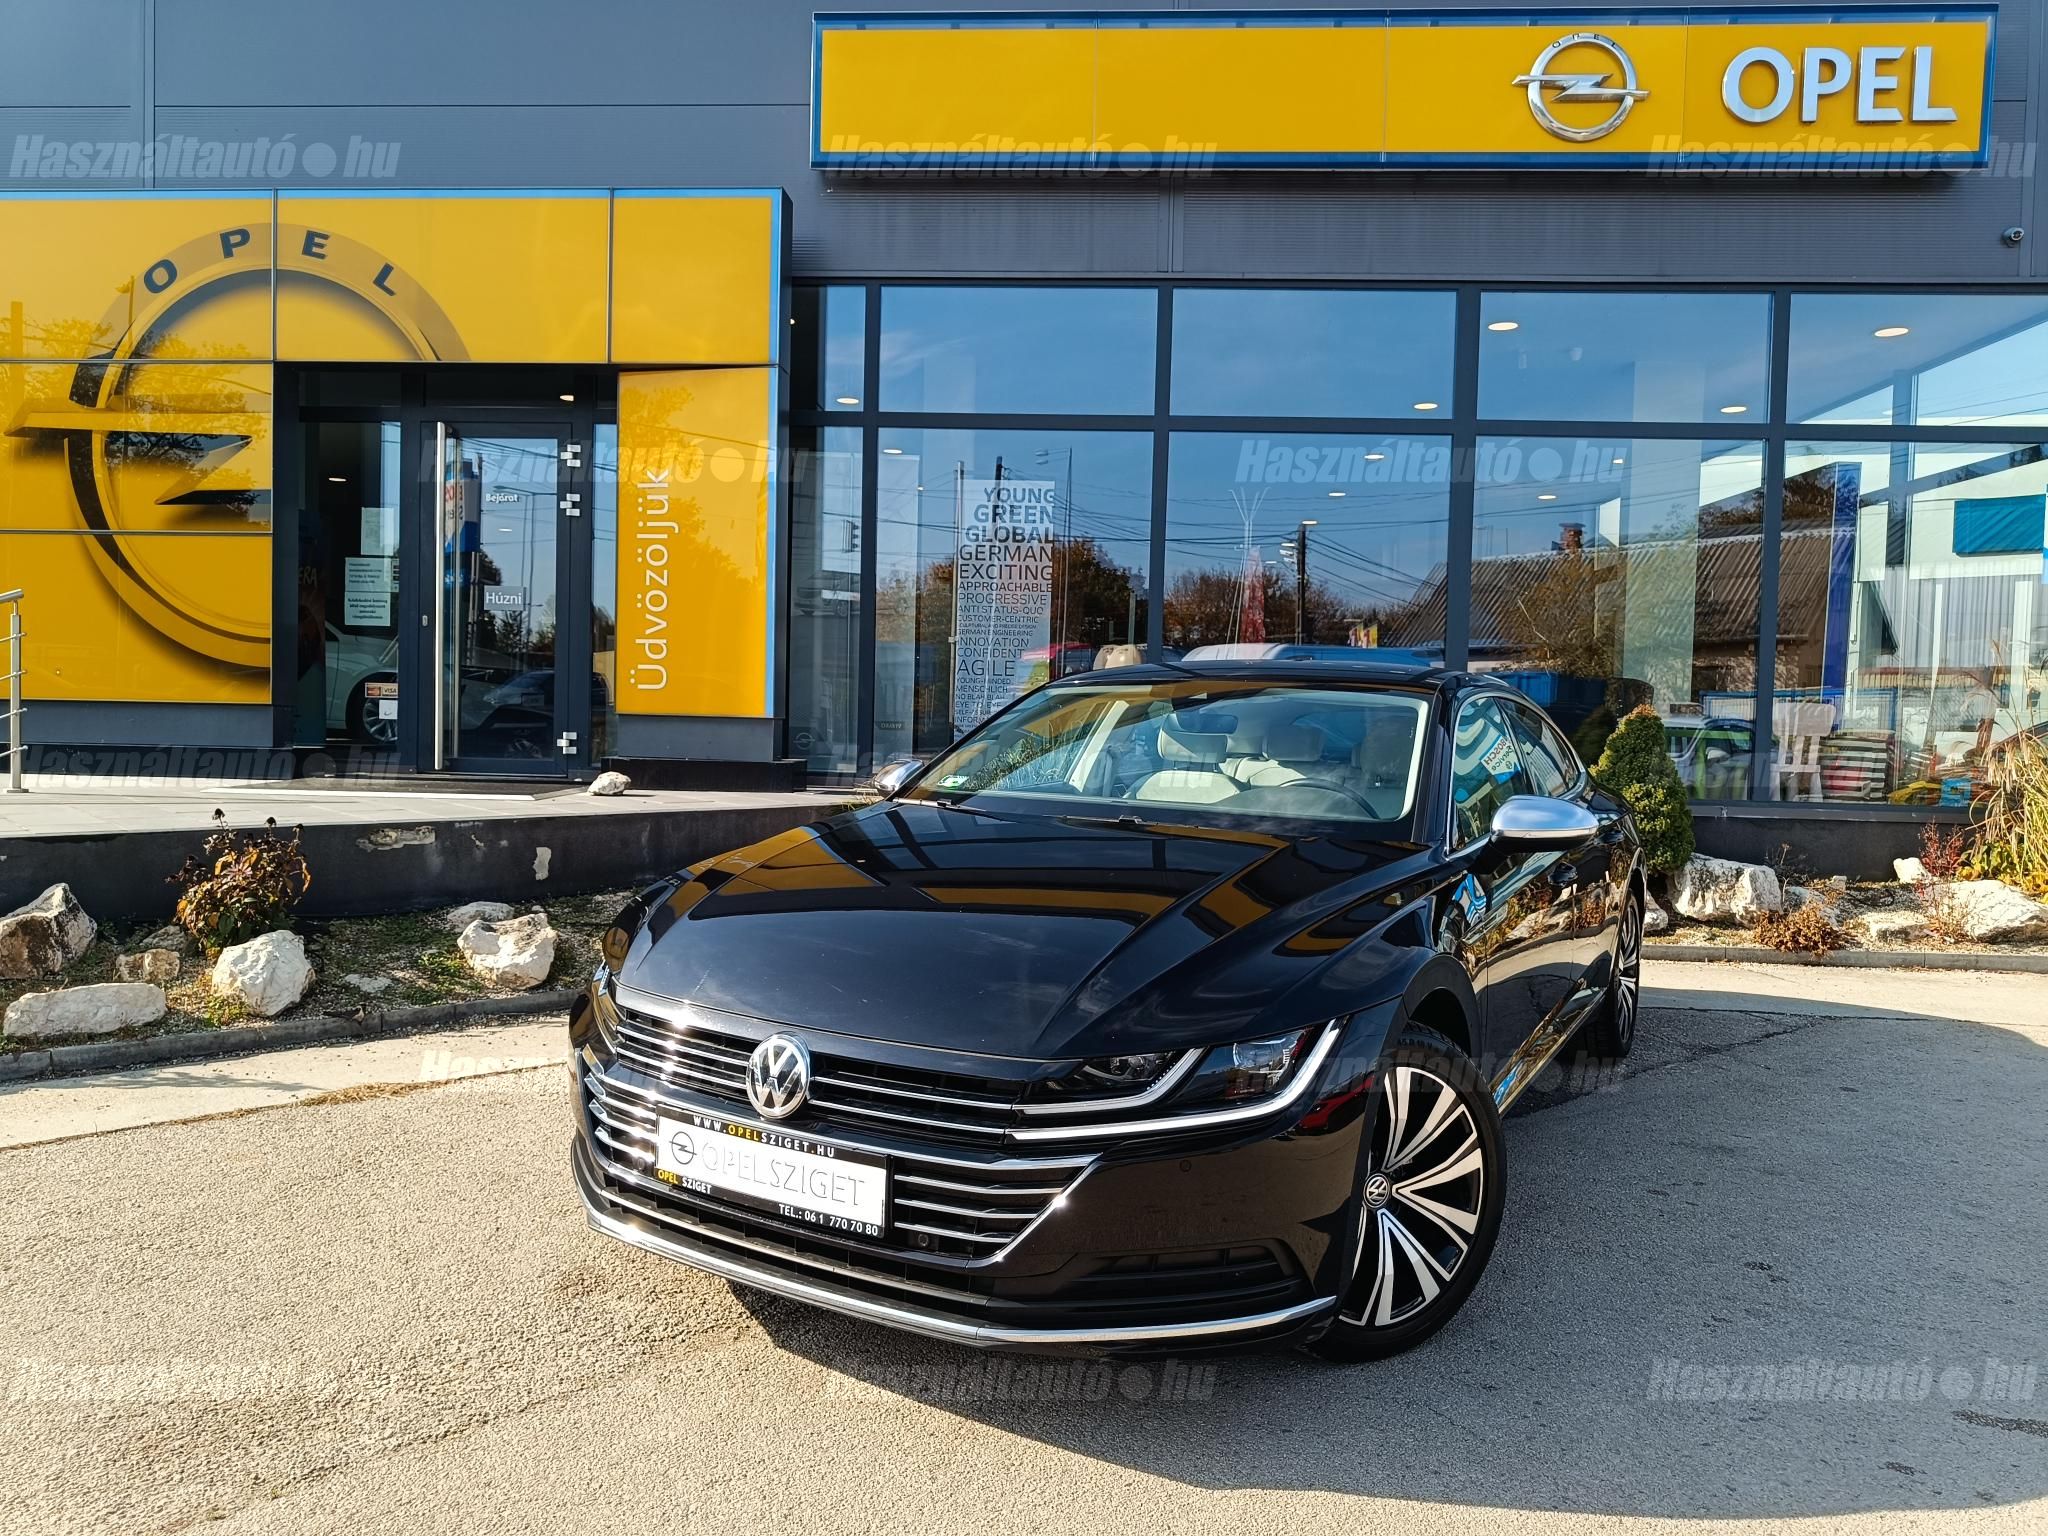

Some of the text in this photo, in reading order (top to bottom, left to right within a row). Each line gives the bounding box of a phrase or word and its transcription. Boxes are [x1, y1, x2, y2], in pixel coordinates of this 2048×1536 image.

[1721, 46, 1958, 124] OPEL
[143, 228, 398, 297] OPEL
[485, 493, 519, 503] Bejárat
[974, 504, 1053, 524] GREEN
[965, 525, 1053, 544] GLOBAL
[959, 544, 1052, 562] GERMAN
[629, 467, 680, 691] Üdvözöljük
[959, 563, 1052, 581] EXCITING
[959, 581, 1052, 592] APPROACHABLE
[485, 591, 522, 605] Húzni
[959, 592, 1047, 605] PROGRESSIVE
[959, 604, 1044, 615] ANTI STATUS-QUO
[958, 614, 1039, 624] CUSTOMER-CENTRIC
[957, 637, 1029, 649] INNOVATION
[957, 647, 1025, 659] CONFIDENT
[957, 659, 1015, 677] AGILE
[693, 1114, 835, 1158] WWW.OPELSZIGET.HU
[657, 1169, 712, 1195] OPEL SZIGET
[779, 1203, 802, 1220] TEL.:
[829, 1215, 848, 1230] 770
[850, 1220, 863, 1232] 70
[865, 1223, 878, 1236] 80
